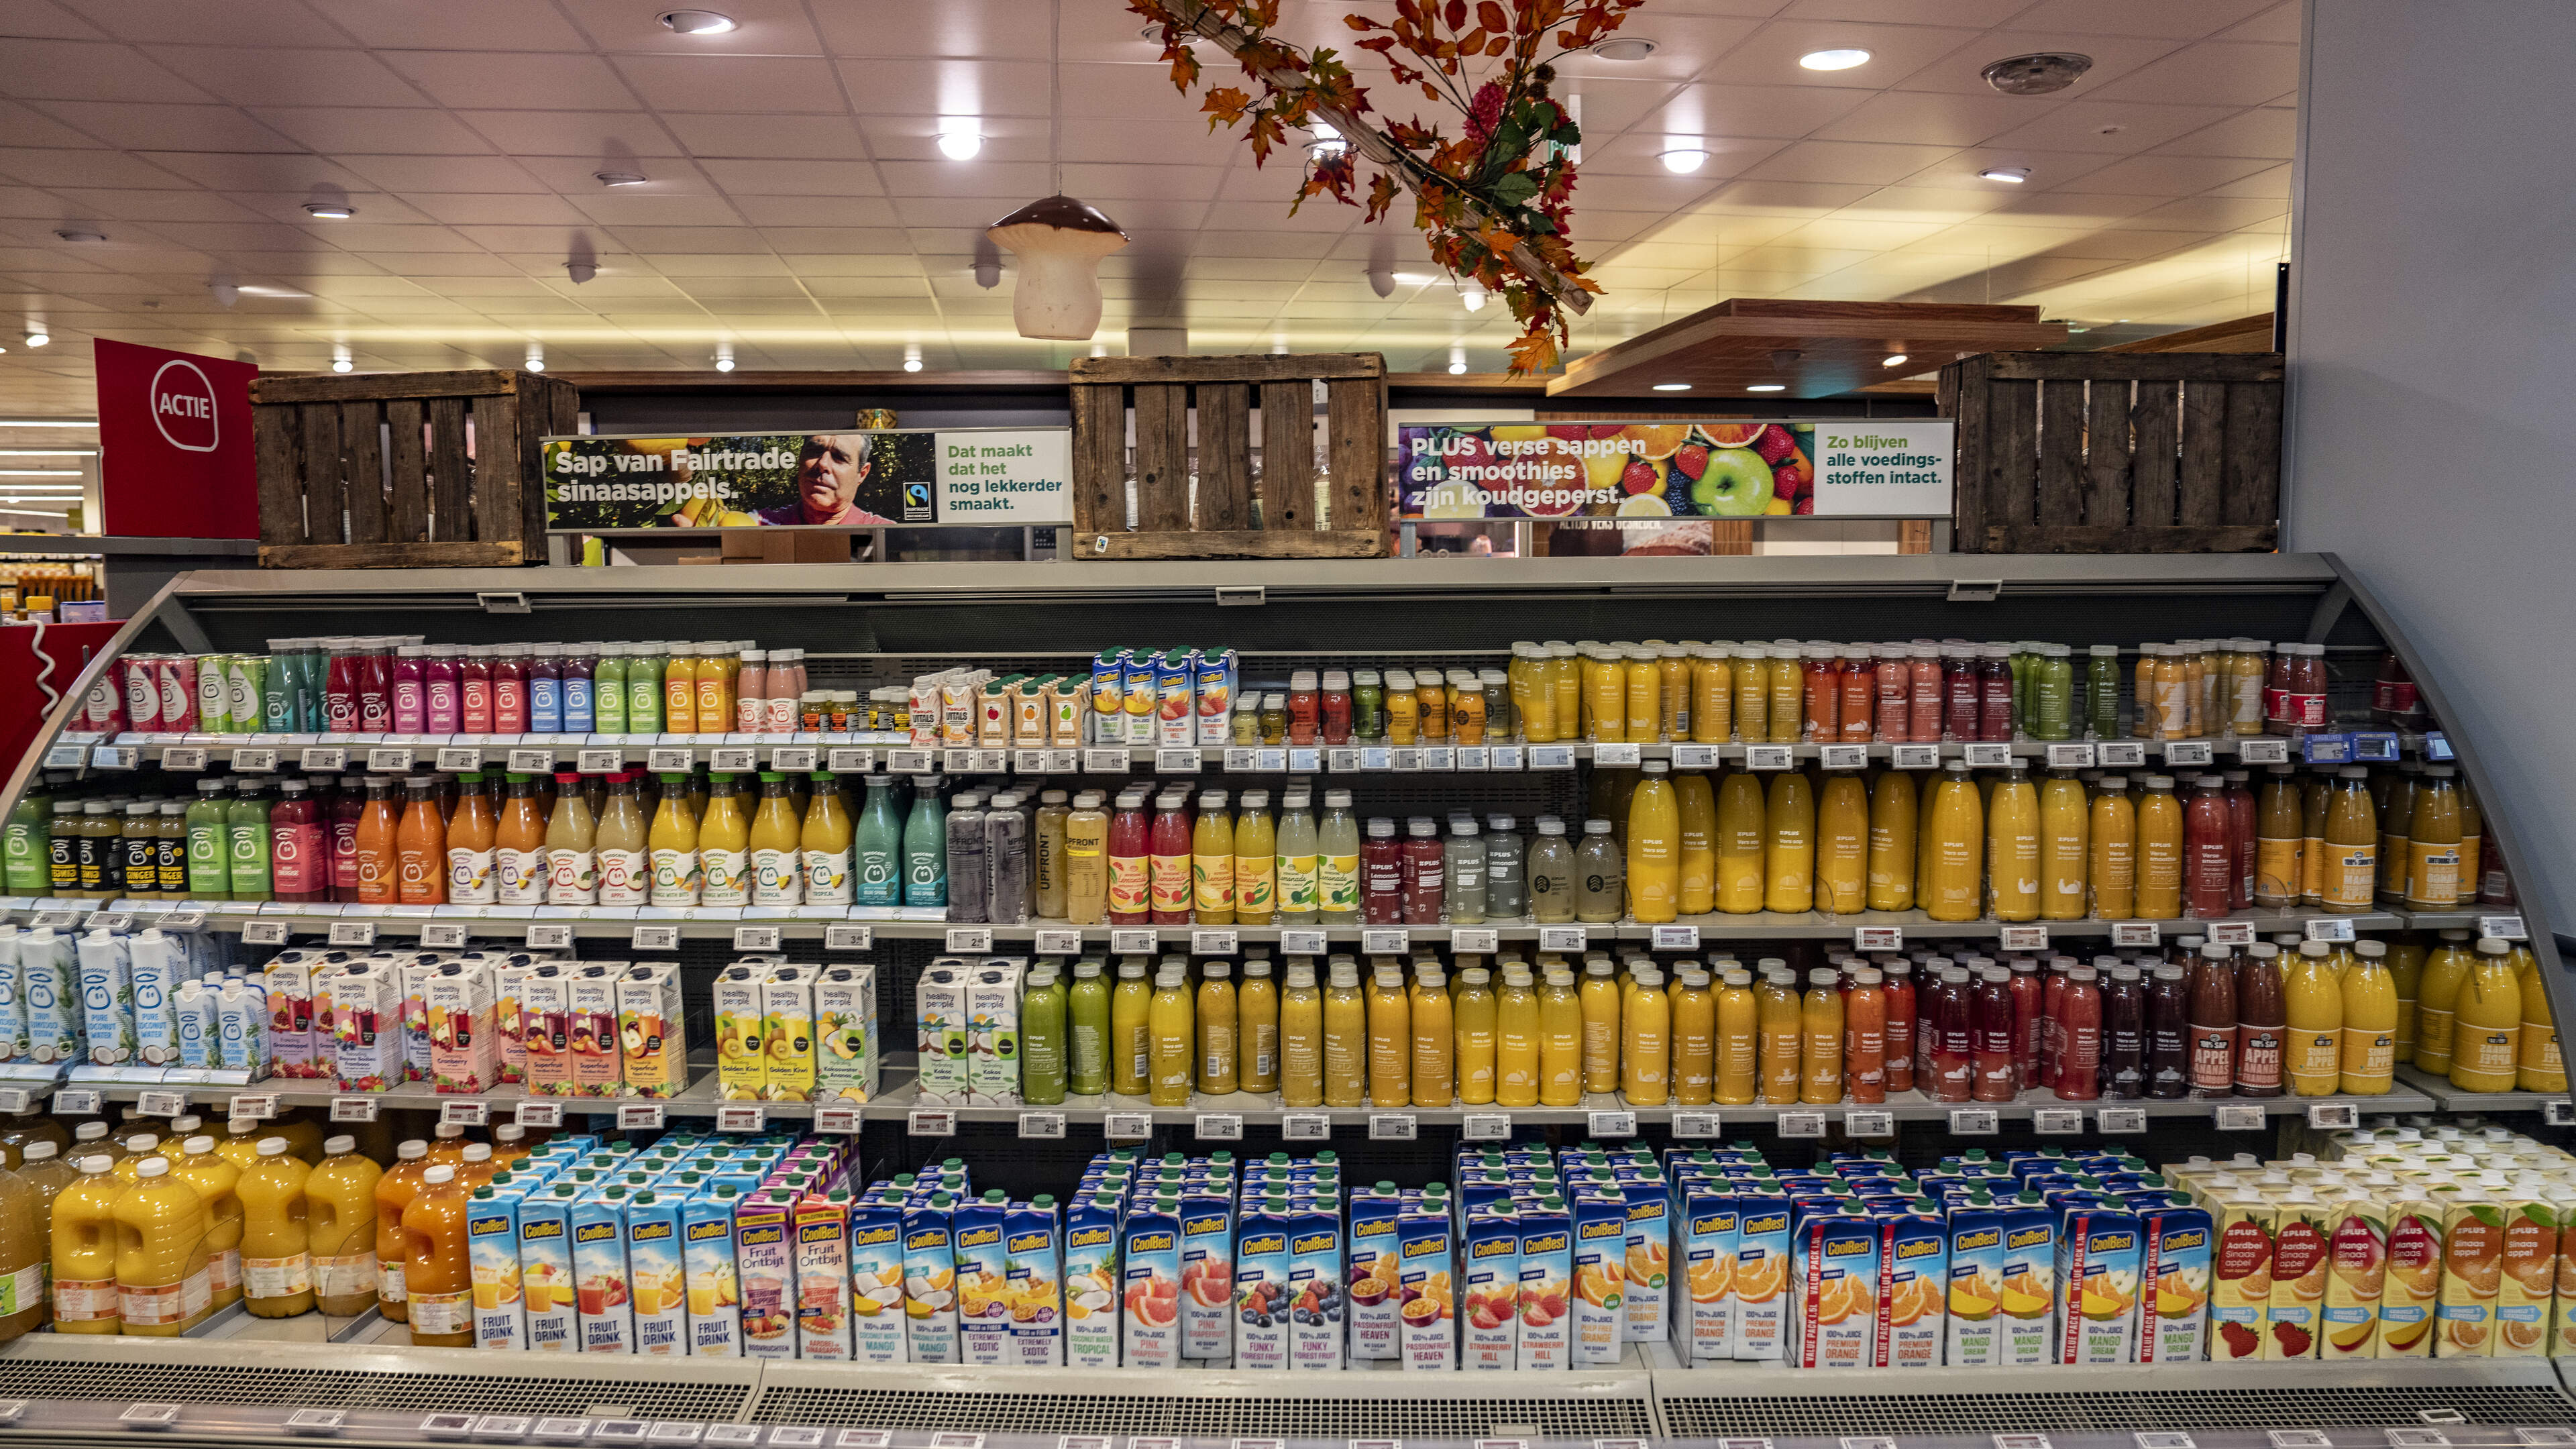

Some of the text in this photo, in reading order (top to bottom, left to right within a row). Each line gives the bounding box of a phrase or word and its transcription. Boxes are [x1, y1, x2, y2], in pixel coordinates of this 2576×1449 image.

[159, 392, 211, 419] ACTIE
[1411, 437, 1646, 460] PLUS verse sappen
[1827, 434, 1908, 450] Zo blijven
[948, 444, 1032, 458] Dat maakt
[556, 447, 796, 478] Sap van Fairtrade
[1827, 452, 1941, 470] alle voedings-
[949, 462, 1006, 475] dat het
[1412, 461, 1576, 481] en smoothies
[1827, 470, 1941, 484] stoffen intact.
[557, 478, 739, 504] sinaasappels.
[949, 479, 1062, 494] nog lekkerder
[1411, 486, 1625, 508] zijn koudgeperst.
[950, 498, 1014, 511] smaakt.
[913, 714, 934, 722] VITALS
[946, 712, 967, 720] VITALS
[1040, 833, 1049, 890] UPFRONT
[126, 871, 156, 880] GINGER
[338, 983, 366, 994] healthy
[433, 985, 460, 996] healthy
[624, 989, 652, 999] healthy
[722, 990, 750, 999] healthy
[824, 990, 852, 1000] healthy
[926, 993, 955, 1002] healthy
[975, 993, 1005, 1002] healthy
[2194, 1049, 2229, 1064] APPEL
[2245, 1049, 2279, 1063] APPEL
[472, 1218, 508, 1235] CoolBest
[525, 1221, 562, 1239] CoolBest
[634, 1222, 671, 1240] CoolBest
[690, 1222, 727, 1240] CoolBest
[1186, 1218, 1226, 1235] CoolBest
[1356, 1220, 1395, 1237] CoolBest
[1582, 1222, 1622, 1239] CoolBest
[1695, 1216, 1735, 1233] CoolBest
[1746, 1216, 1785, 1233] CoolBest
[743, 1228, 782, 1244] CoolBest
[802, 1225, 840, 1242] CoolBest
[858, 1228, 897, 1245] CoolBest
[908, 1232, 947, 1248] CoolBest
[960, 1229, 999, 1246] CoolBest
[1072, 1229, 1111, 1246] CoolBest
[1958, 1232, 1998, 1248] CoolBest
[2008, 1229, 2049, 1247] CoolBest
[1010, 1234, 1049, 1252] CoolBest
[1132, 1236, 1172, 1252] CoolBest
[1244, 1237, 1283, 1255] CoolBest
[1295, 1236, 1334, 1254] CoolBest
[1525, 1237, 1565, 1254] CoolBest
[2091, 1237, 2132, 1252] CoolBest
[2164, 1233, 2202, 1249] CoolBest
[2339, 1243, 2369, 1251] Mango
[2394, 1242, 2424, 1250] Mango
[749, 1247, 776, 1257] Fruit
[808, 1244, 835, 1255] Fruit
[1405, 1240, 1445, 1256] CoolBest
[1474, 1241, 1515, 1258] CoolBest
[1827, 1240, 1868, 1256] CoolBest
[1898, 1242, 1938, 1257] CoolBest
[2225, 1250, 2255, 1258] Sinaas
[742, 1255, 785, 1269] Ontbijt
[800, 1253, 843, 1267] Ontbijt
[2074, 1248, 2084, 1267] PACK
[2225, 1259, 2251, 1267] appel
[2279, 1260, 2306, 1268] appel
[2072, 1269, 2084, 1291] VALUE
[482, 1315, 511, 1328] FRUIT
[535, 1318, 564, 1330] FRUIT
[588, 1320, 618, 1333] FRUIT
[643, 1320, 674, 1333] FRUIT
[698, 1320, 727, 1334] FRUIT
[1695, 1320, 1725, 1328] PREMIUM
[1746, 1320, 1776, 1328] PREMIUM
[482, 1326, 514, 1340] DRINK
[535, 1329, 567, 1342] DRINK
[588, 1331, 621, 1344] DRINK
[643, 1331, 676, 1345] DRINK
[698, 1332, 731, 1346] DRINK
[1360, 1330, 1390, 1340] HEAVEN
[1581, 1332, 1611, 1342] ORANGE
[1695, 1328, 1725, 1338] ORANGE
[1746, 1328, 1776, 1338] ORANGE
[2163, 1334, 2194, 1343] MANGO
[865, 1341, 895, 1351] MANGO
[918, 1342, 947, 1352] MANGO
[973, 1342, 999, 1352] EXOTIC
[1140, 1340, 1159, 1349] PINK
[1249, 1342, 1275, 1352] FUNKY
[1302, 1341, 1327, 1351] FUNKY
[1469, 1343, 1511, 1351] STRAWBERRY
[1522, 1341, 1564, 1349] STRAWBERRY
[1826, 1340, 1860, 1348] PREMIUM
[1898, 1340, 1932, 1349] PREMIUM
[1961, 1338, 1990, 1347] MANGO
[2088, 1336, 2121, 1346] MANGO
[1022, 1347, 1049, 1356] EXOTIC
[1073, 1344, 1111, 1354] TROPICAL
[1535, 1350, 1551, 1360] HILL
[1825, 1348, 1860, 1359] ORANGE
[1898, 1349, 1932, 1359] ORANGE
[1414, 1352, 1444, 1361] HEAVEN
[1482, 1352, 1497, 1361] HILL
